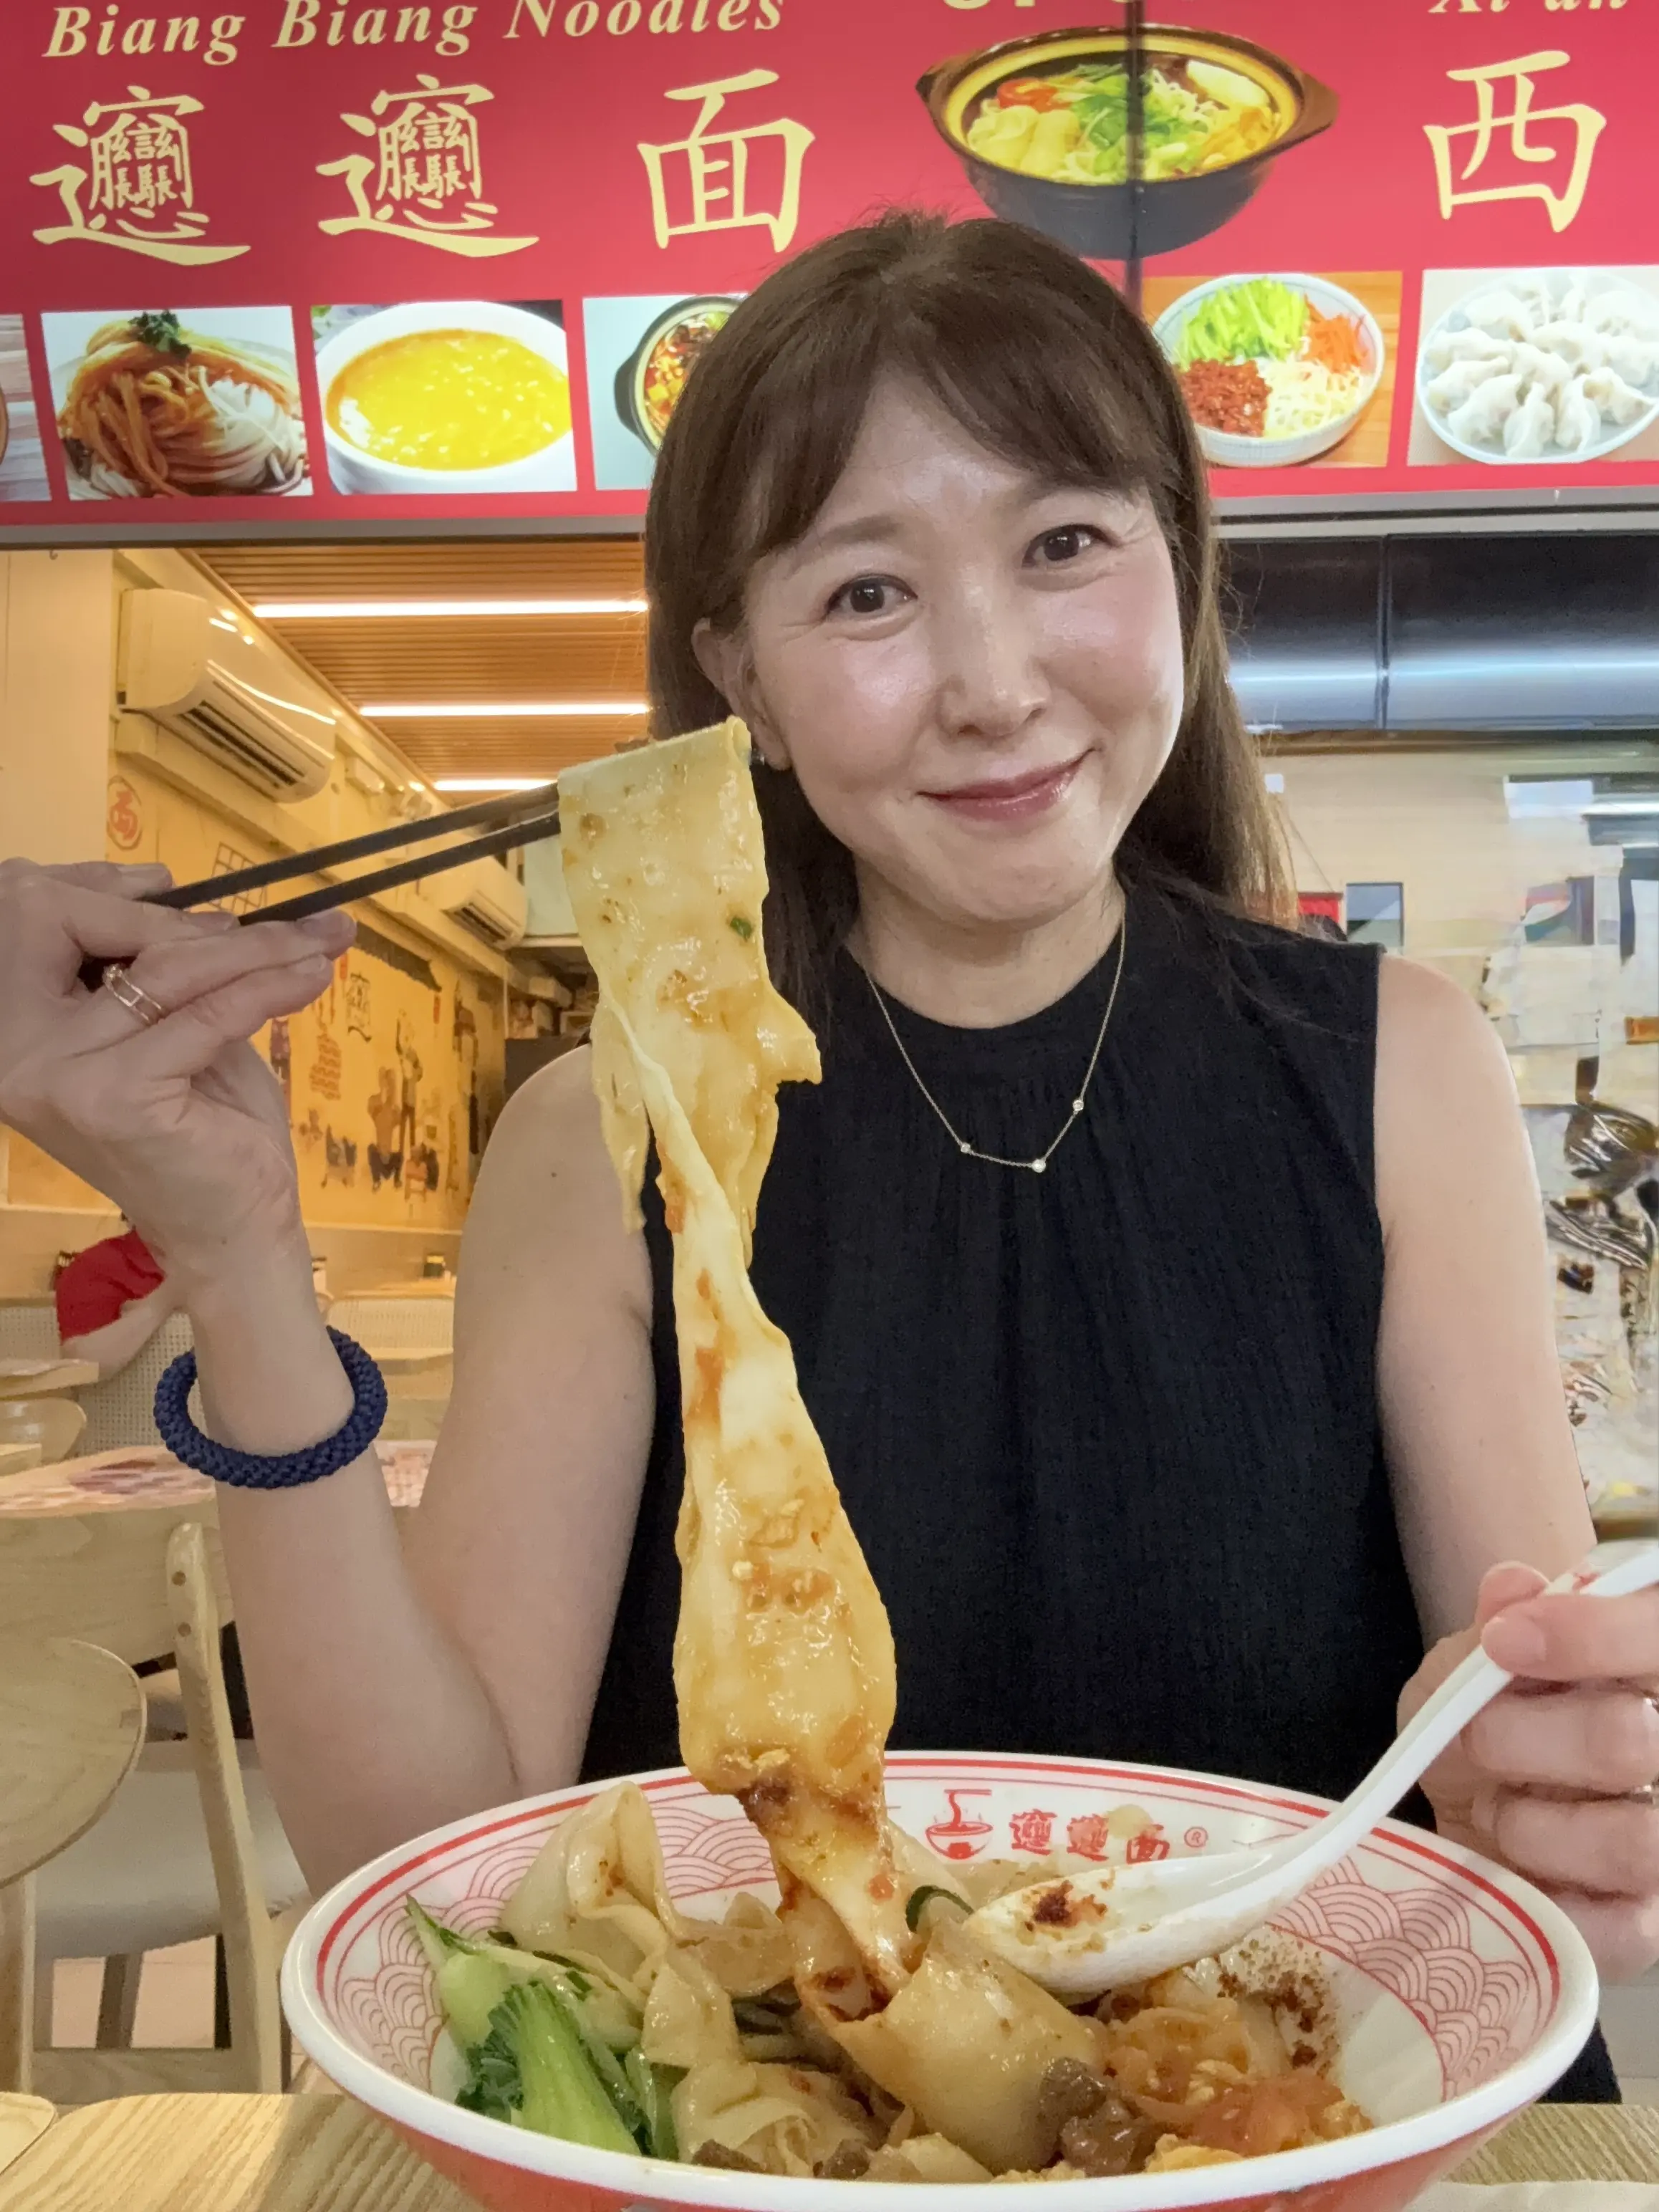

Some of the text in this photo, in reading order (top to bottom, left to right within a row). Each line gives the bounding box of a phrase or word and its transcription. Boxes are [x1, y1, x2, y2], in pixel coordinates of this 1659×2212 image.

[43, 4, 245, 65] Biang
[273, 0, 477, 57] Biang
[1423, 49, 1607, 233] 西
